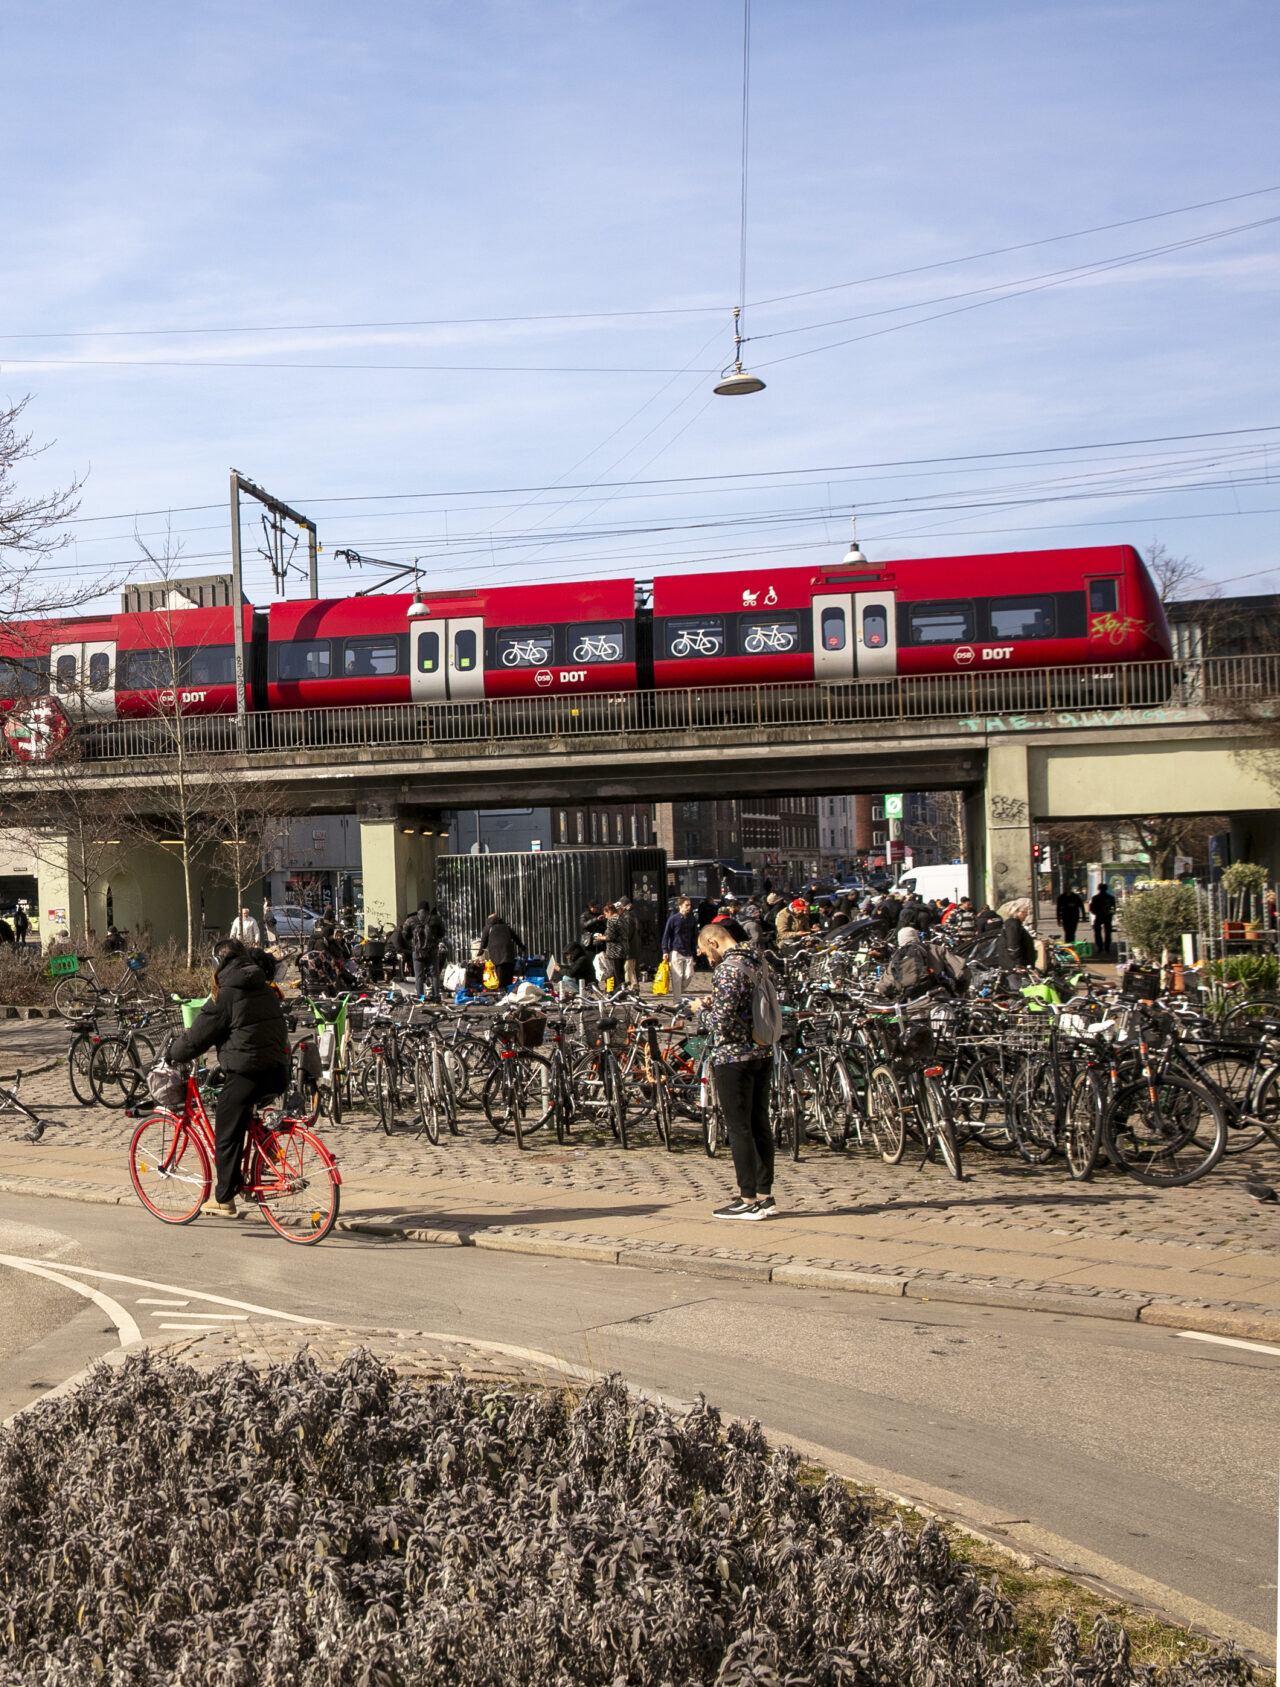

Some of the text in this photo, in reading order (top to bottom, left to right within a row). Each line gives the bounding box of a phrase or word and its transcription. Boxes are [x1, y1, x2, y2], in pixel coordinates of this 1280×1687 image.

[982, 648, 1014, 660] DOT
[537, 671, 587, 683] DSB DOT
[182, 691, 207, 703] DOT
